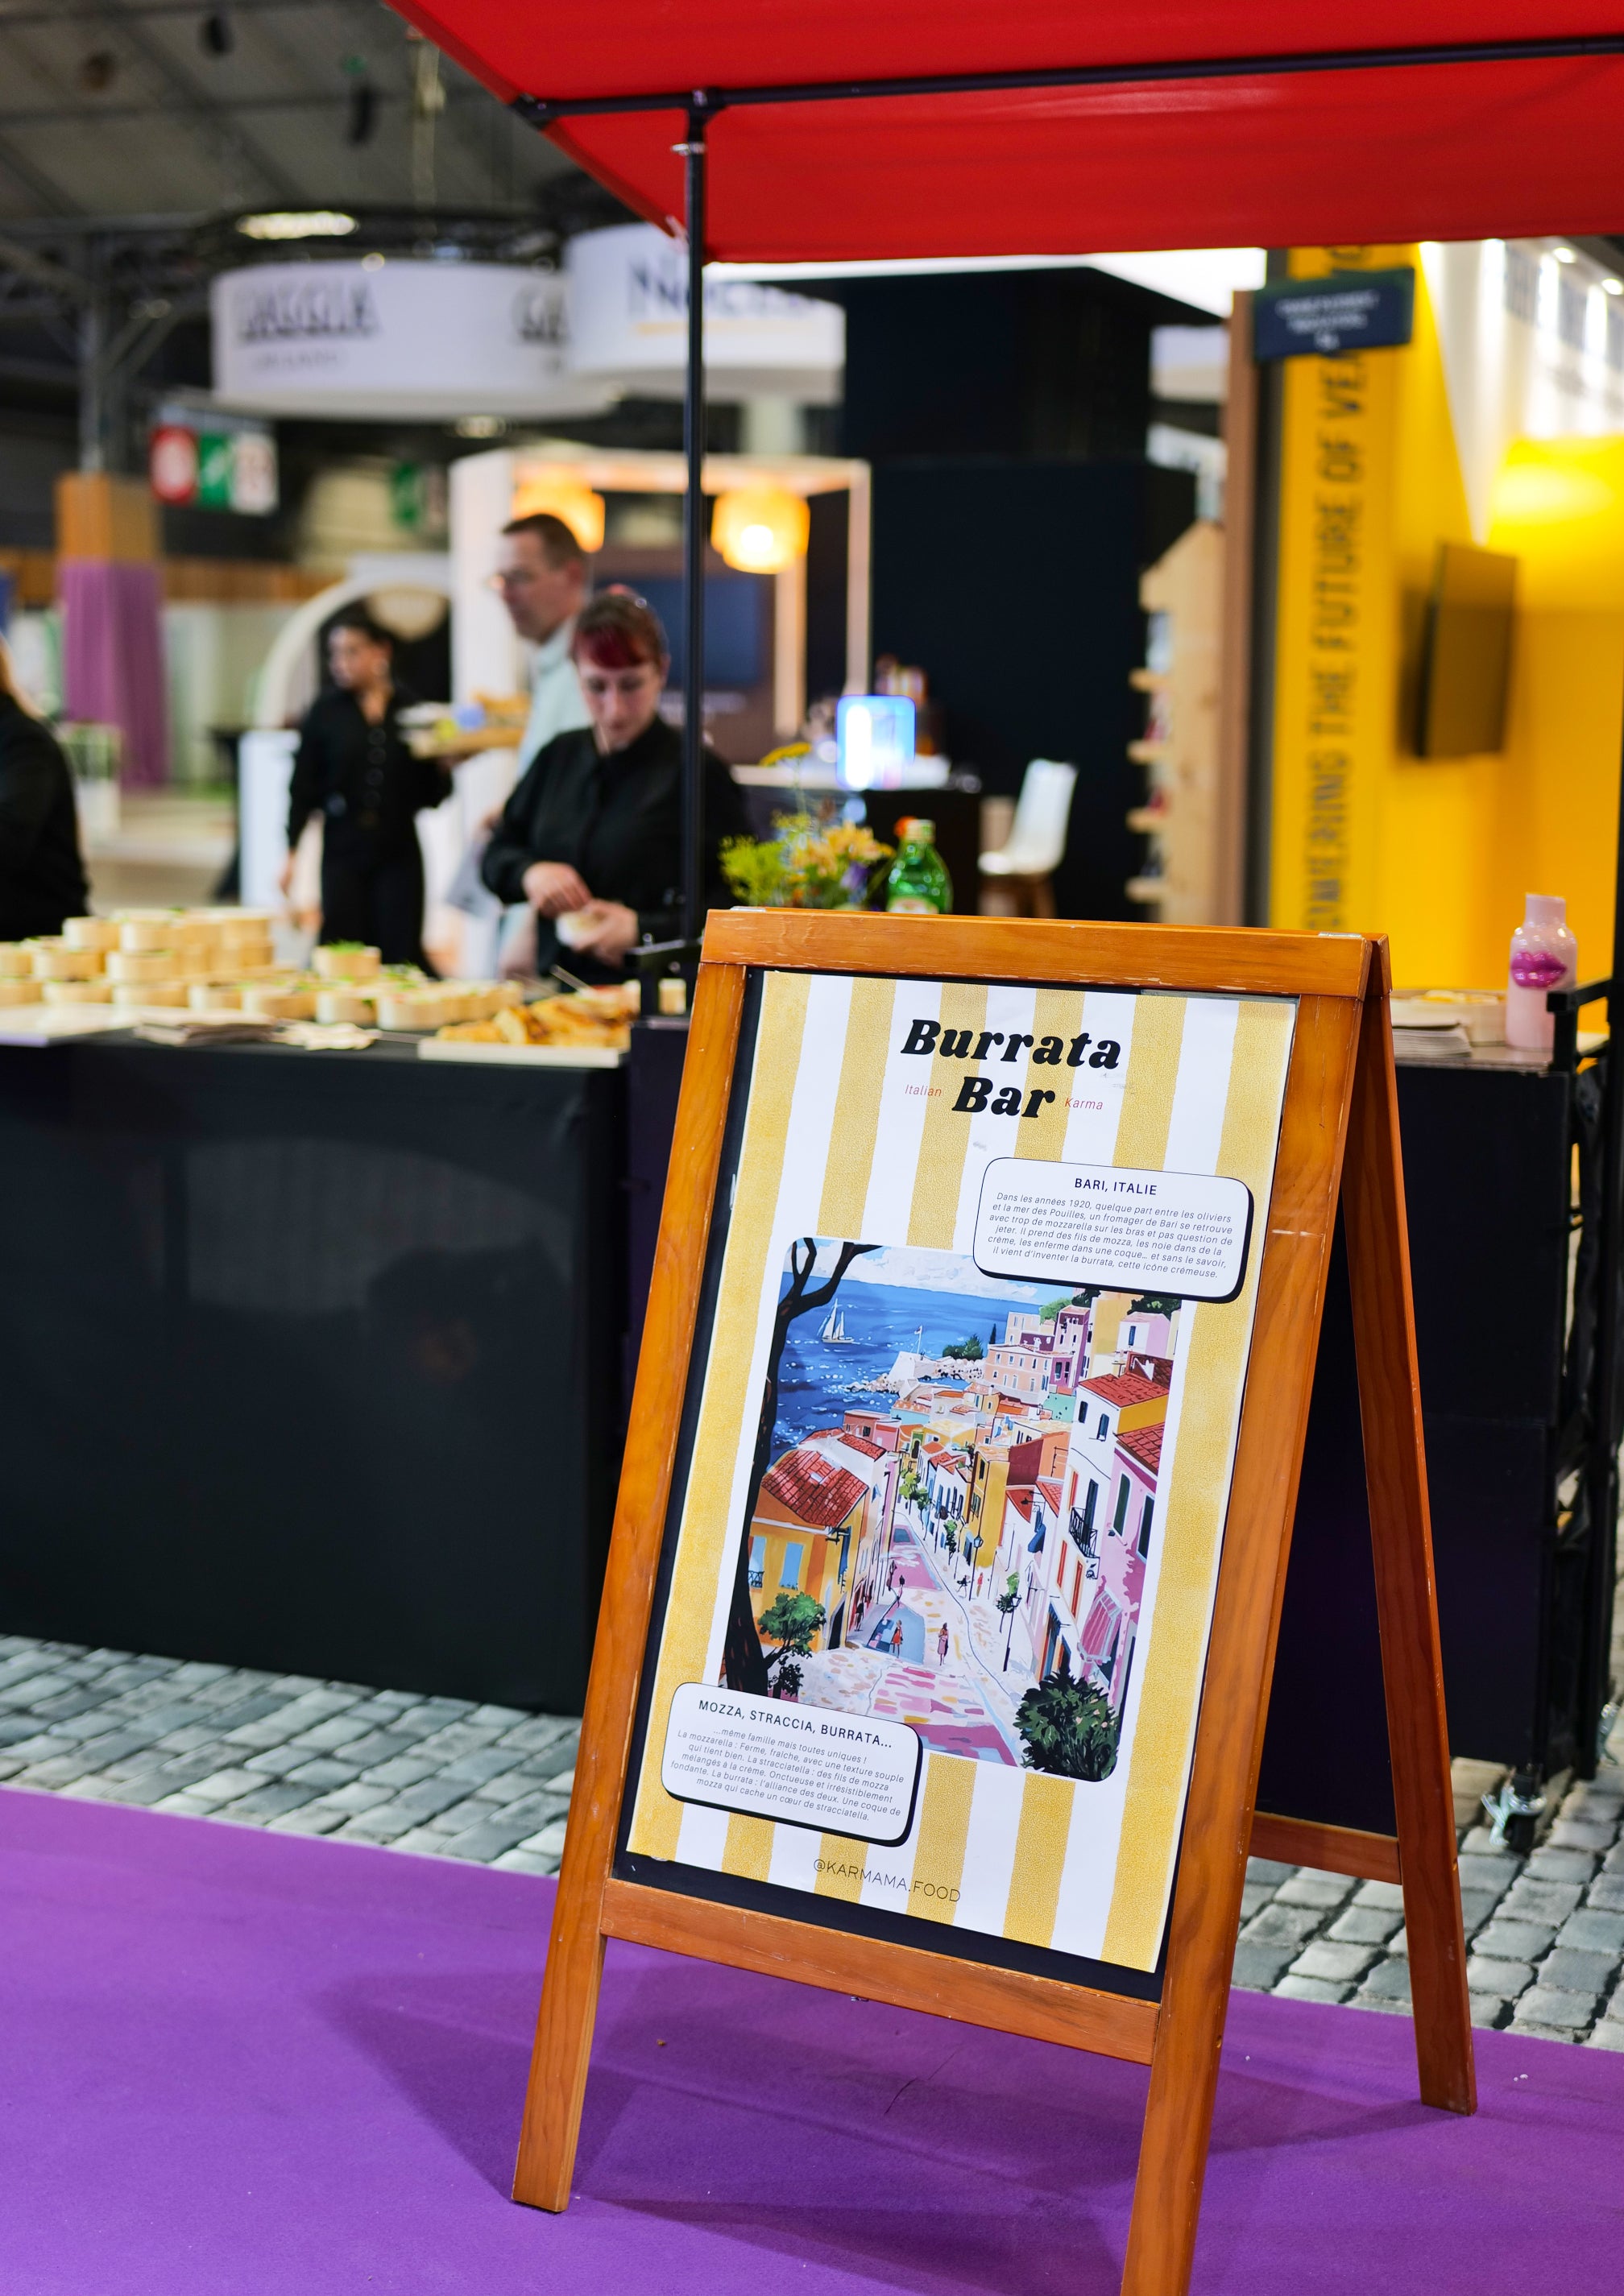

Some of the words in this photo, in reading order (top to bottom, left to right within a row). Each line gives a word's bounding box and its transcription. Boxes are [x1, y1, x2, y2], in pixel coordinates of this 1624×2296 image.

[900, 1019, 1121, 1069] Burrata
[905, 1084, 942, 1097] Italian
[951, 1076, 1056, 1119] Bar
[1064, 1097, 1104, 1111] Karma
[1075, 1177, 1108, 1193] BARI,
[1113, 1181, 1158, 1196] ITALIE
[992, 1202, 1001, 1210] et
[1002, 1202, 1012, 1212] la
[1013, 1206, 1030, 1214] mer
[1031, 1206, 1047, 1216] des
[1048, 1207, 1086, 1221] Pouilles,
[1088, 1213, 1101, 1221] un
[1102, 1212, 1145, 1227] fromager
[1145, 1217, 1158, 1227] de
[1158, 1218, 1179, 1229] Bari
[1179, 1222, 1191, 1230] se
[1191, 1223, 1232, 1235] retrouve
[996, 1191, 1018, 1202] Dans
[1019, 1194, 1033, 1203] les
[1034, 1197, 1067, 1206] années
[1069, 1198, 1092, 1210] 1920,
[1095, 1202, 1133, 1214] quelque
[1133, 1206, 1153, 1215] part
[1154, 1208, 1179, 1218] entre
[1180, 1209, 1195, 1219] les
[1196, 1211, 1232, 1223] oliviers
[988, 1214, 1009, 1222] avec
[1010, 1215, 1030, 1227] trop
[1031, 1216, 1043, 1227] de
[1044, 1219, 1092, 1231] mozzarella
[1093, 1224, 1109, 1233] sur
[1109, 1224, 1124, 1235] les
[1125, 1226, 1146, 1237] bras
[1146, 1230, 1156, 1238] et
[1157, 1231, 1174, 1240] pas
[1176, 1233, 1218, 1244] question
[1220, 1236, 1232, 1246] de
[996, 1224, 1017, 1235] jeter.
[1019, 1227, 1026, 1235] Il
[1026, 1229, 1054, 1239] prend
[1055, 1231, 1072, 1240] des
[1073, 1231, 1088, 1242] fils
[1088, 1233, 1101, 1243] de
[1102, 1236, 1133, 1247] mozza,
[1135, 1238, 1150, 1248] les
[1150, 1241, 1172, 1251] noie
[1173, 1243, 1196, 1253] dans
[1198, 1245, 1211, 1255] de
[1212, 1246, 1222, 1256] la
[992, 1245, 999, 1254] il
[1000, 1247, 1023, 1256] vient
[1070, 1253, 1079, 1263] la
[1080, 1254, 1115, 1268] burrata,
[1117, 1260, 1141, 1269] cette
[1018, 1237, 1032, 1247] les
[1033, 1239, 1070, 1251] enferme
[1071, 1242, 1093, 1254] dans
[1094, 1247, 1112, 1256] une
[1150, 1252, 1160, 1260] et
[1161, 1254, 1183, 1263] sans
[1184, 1255, 1194, 1264] le
[1195, 1257, 1226, 1269] savoir,
[698, 1699, 745, 1720] MOZZA,
[749, 1710, 816, 1734] STRACCIA,
[820, 1723, 892, 1748] BURRATA...
[677, 1729, 687, 1738] La
[689, 1732, 733, 1748] mozzarella
[739, 1741, 767, 1756] Ferme,
[802, 1756, 823, 1766] avec
[824, 1760, 842, 1770] une
[842, 1763, 873, 1777] texture
[873, 1771, 905, 1783] souple
[747, 1732, 776, 1746] famille
[777, 1740, 798, 1750] mais
[798, 1744, 826, 1756] toutes
[826, 1750, 862, 1764] uniques
[681, 1752, 721, 1767] mélangés
[722, 1760, 727, 1769] à
[728, 1761, 737, 1771] la
[768, 1769, 814, 1787] Onctueuse
[815, 1781, 825, 1789] et
[826, 1781, 893, 1803] irrésistiblement
[689, 1744, 702, 1752] qui
[703, 1745, 723, 1756] tient
[723, 1749, 744, 1761] bien.
[747, 1754, 757, 1764] La
[758, 1758, 810, 1775] stracciatella
[816, 1769, 832, 1780] des
[833, 1772, 847, 1783] fils
[847, 1775, 860, 1785] de
[860, 1779, 889, 1791] mozza
[670, 1762, 709, 1776] fondante.
[710, 1769, 722, 1778] La
[723, 1771, 753, 1785] burrata
[798, 1787, 815, 1798] des
[816, 1791, 839, 1803] deux.
[842, 1796, 859, 1807] Une
[860, 1802, 888, 1814] coque
[889, 1806, 901, 1816] de
[696, 1777, 723, 1789] mozza
[723, 1784, 739, 1793] qui
[739, 1786, 765, 1798] cache
[766, 1793, 778, 1801] un
[778, 1795, 802, 1806] cœur
[802, 1799, 814, 1809] de
[815, 1803, 869, 1821] stracciatella.
[813, 1859, 962, 1902] @KARMAMA.FOOD
